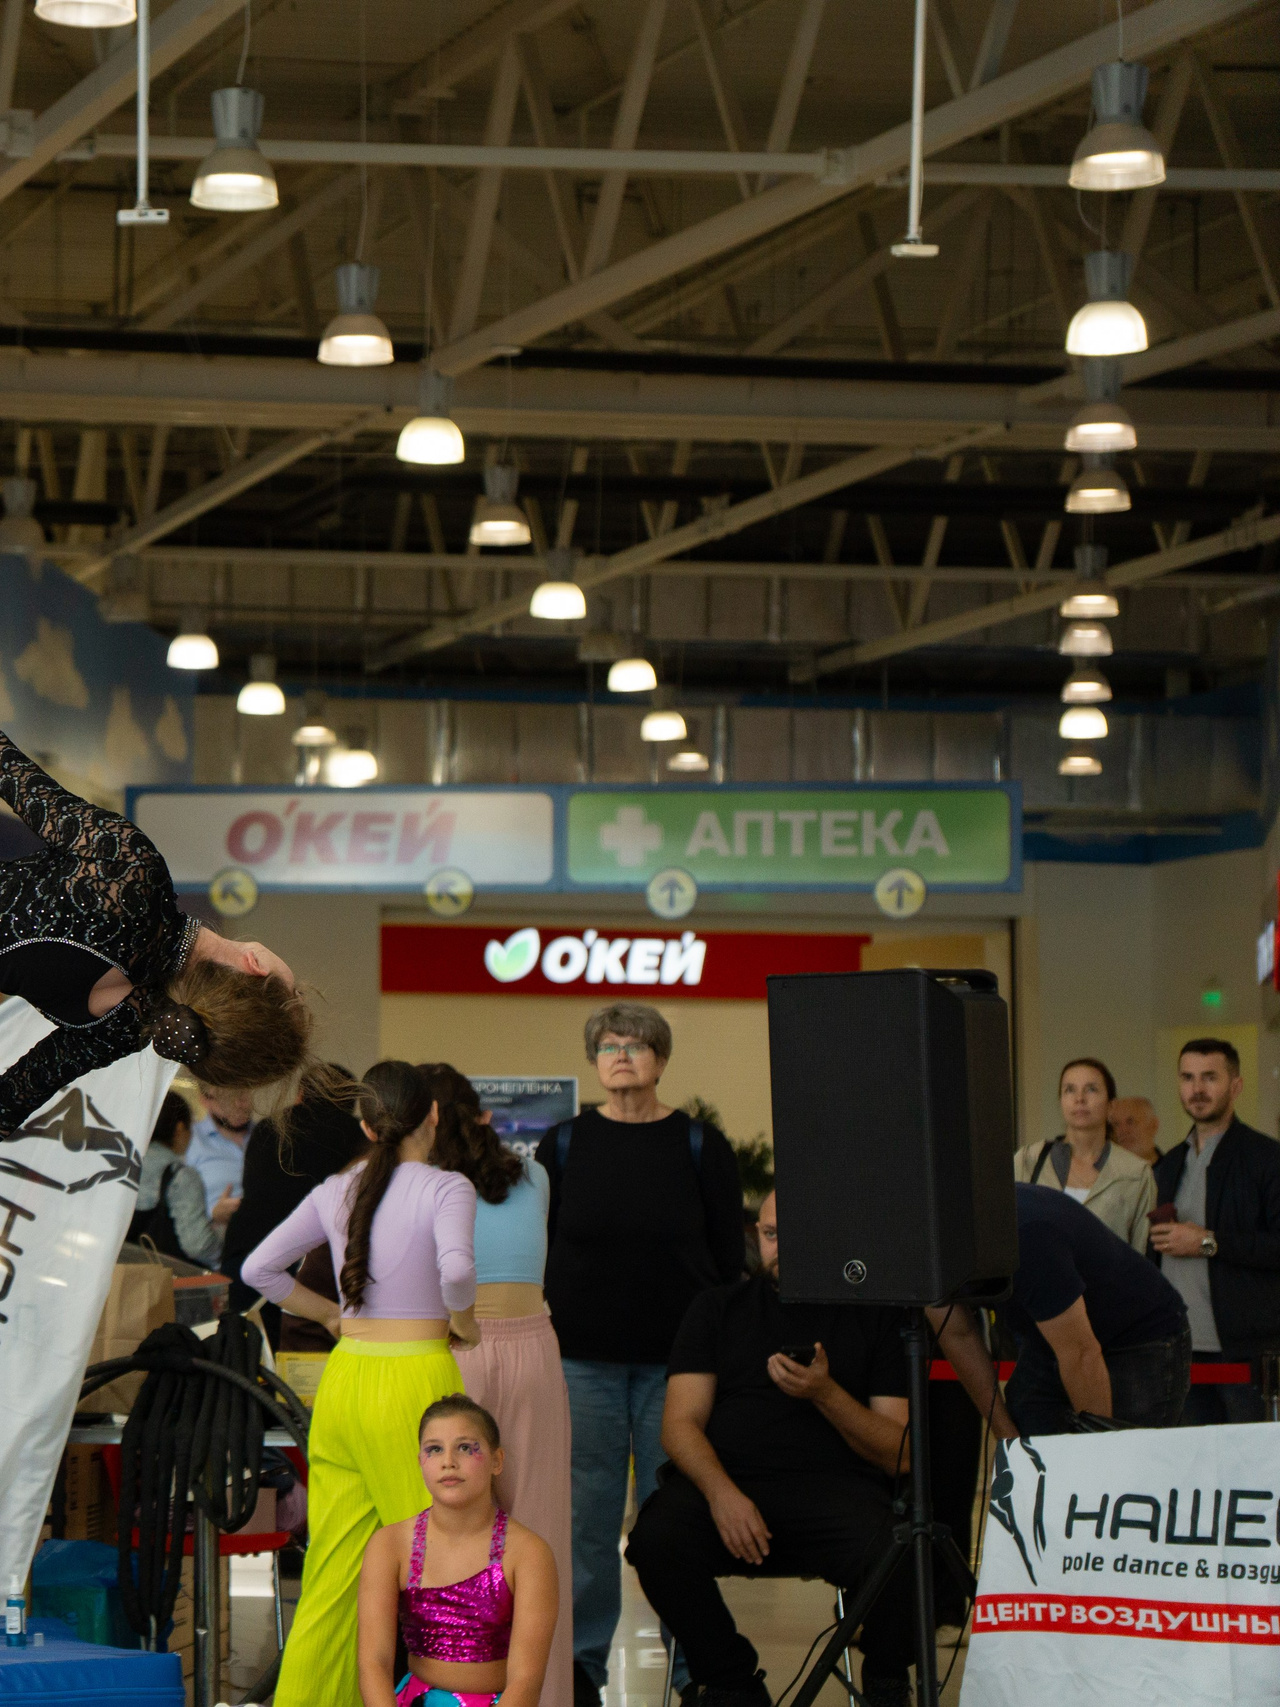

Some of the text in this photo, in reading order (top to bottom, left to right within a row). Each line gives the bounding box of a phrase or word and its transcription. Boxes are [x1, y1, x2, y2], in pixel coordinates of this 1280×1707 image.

[684, 808, 951, 858] АПТЕКА
[1064, 1487, 1280, 1548] НАШЕ
[1062, 1552, 1105, 1575] pole
[1112, 1553, 1189, 1579] dance
[1194, 1558, 1211, 1579] &
[974, 1602, 1280, 1636] ЦЕНТР ВОЗДУШНЫ
